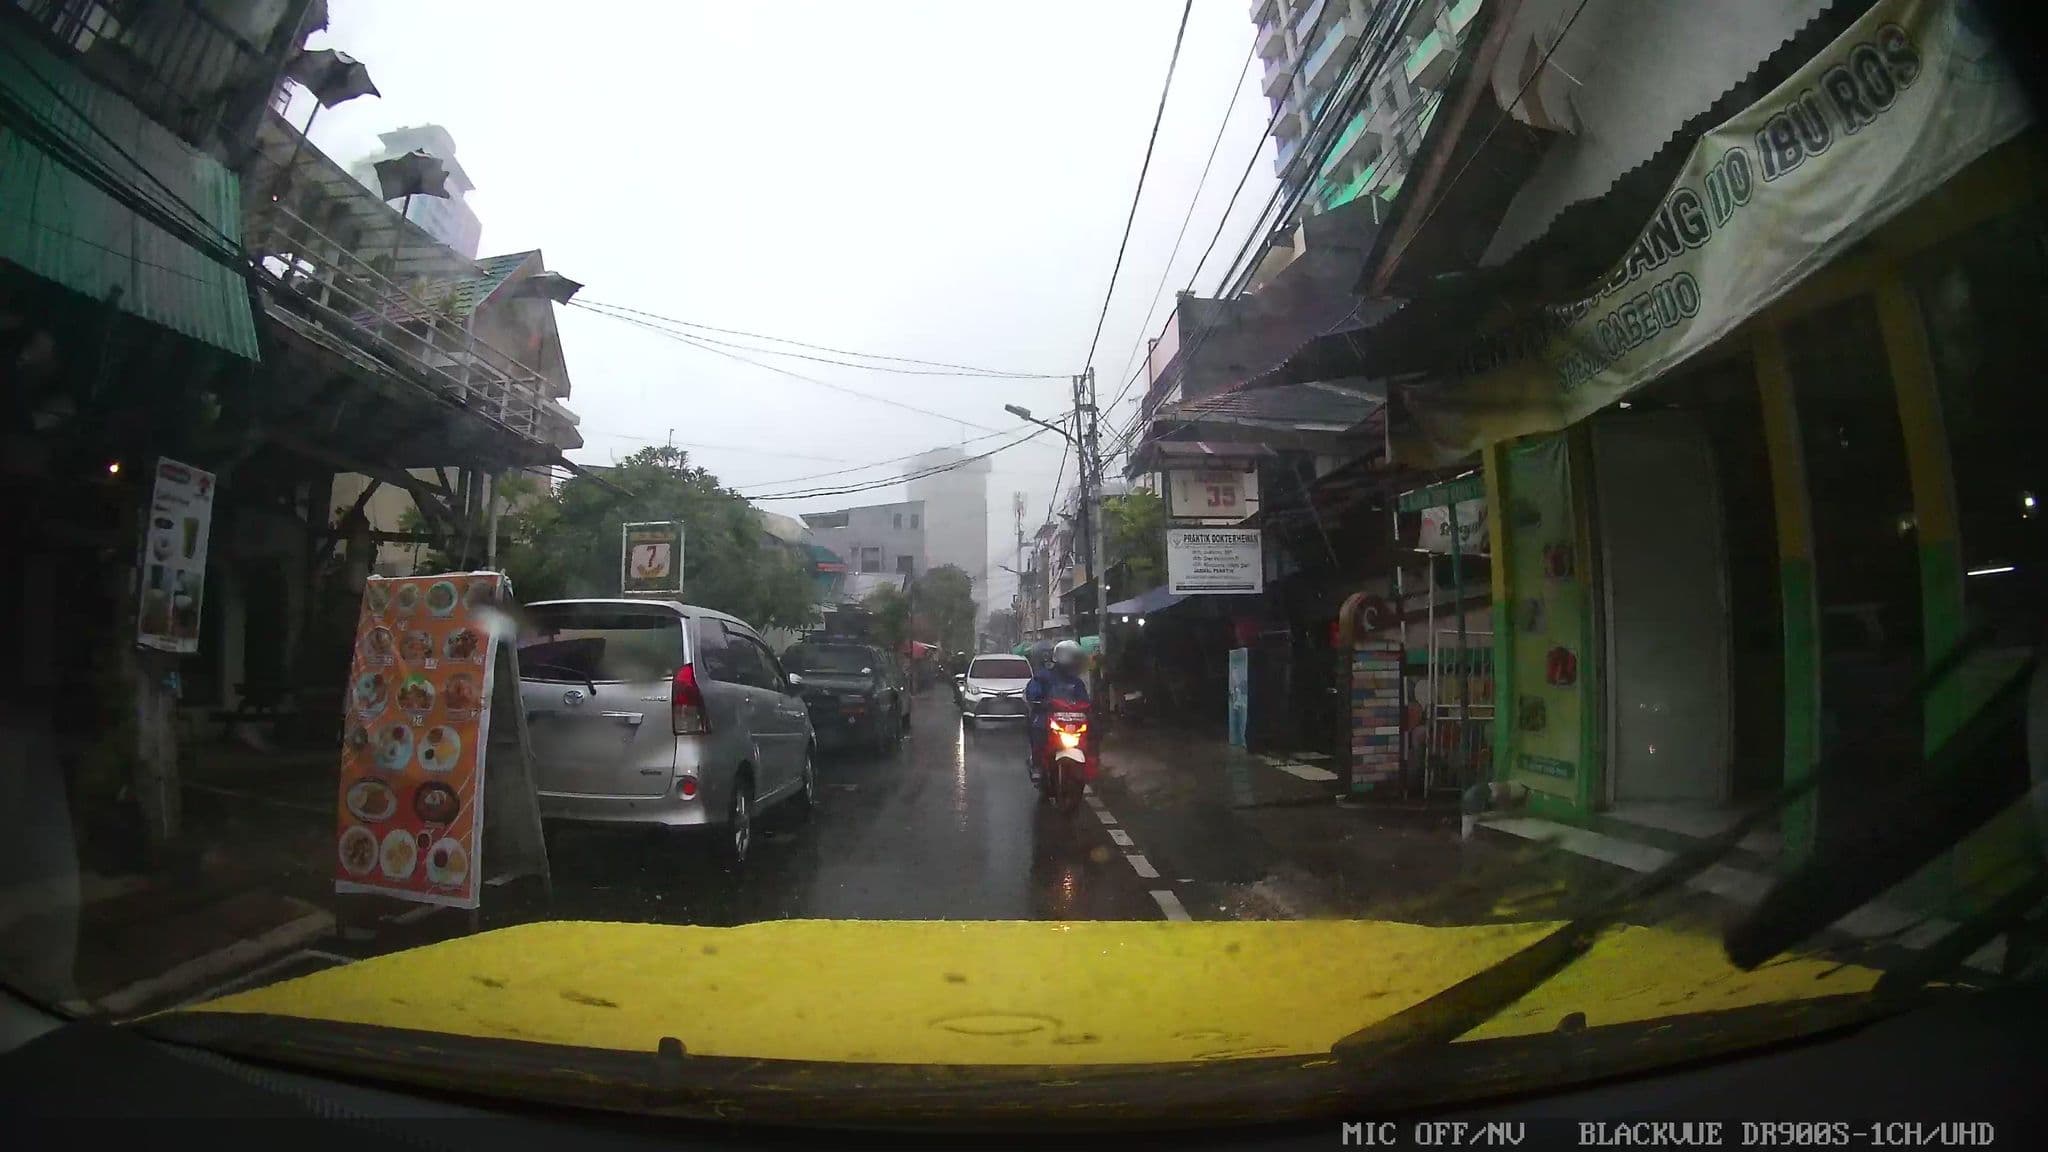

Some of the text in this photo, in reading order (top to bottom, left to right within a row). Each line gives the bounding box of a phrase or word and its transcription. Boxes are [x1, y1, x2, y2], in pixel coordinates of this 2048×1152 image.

[1755, 88, 1833, 182] IBU
[1821, 23, 1920, 135] ROS
[646, 545, 657, 568] 7
